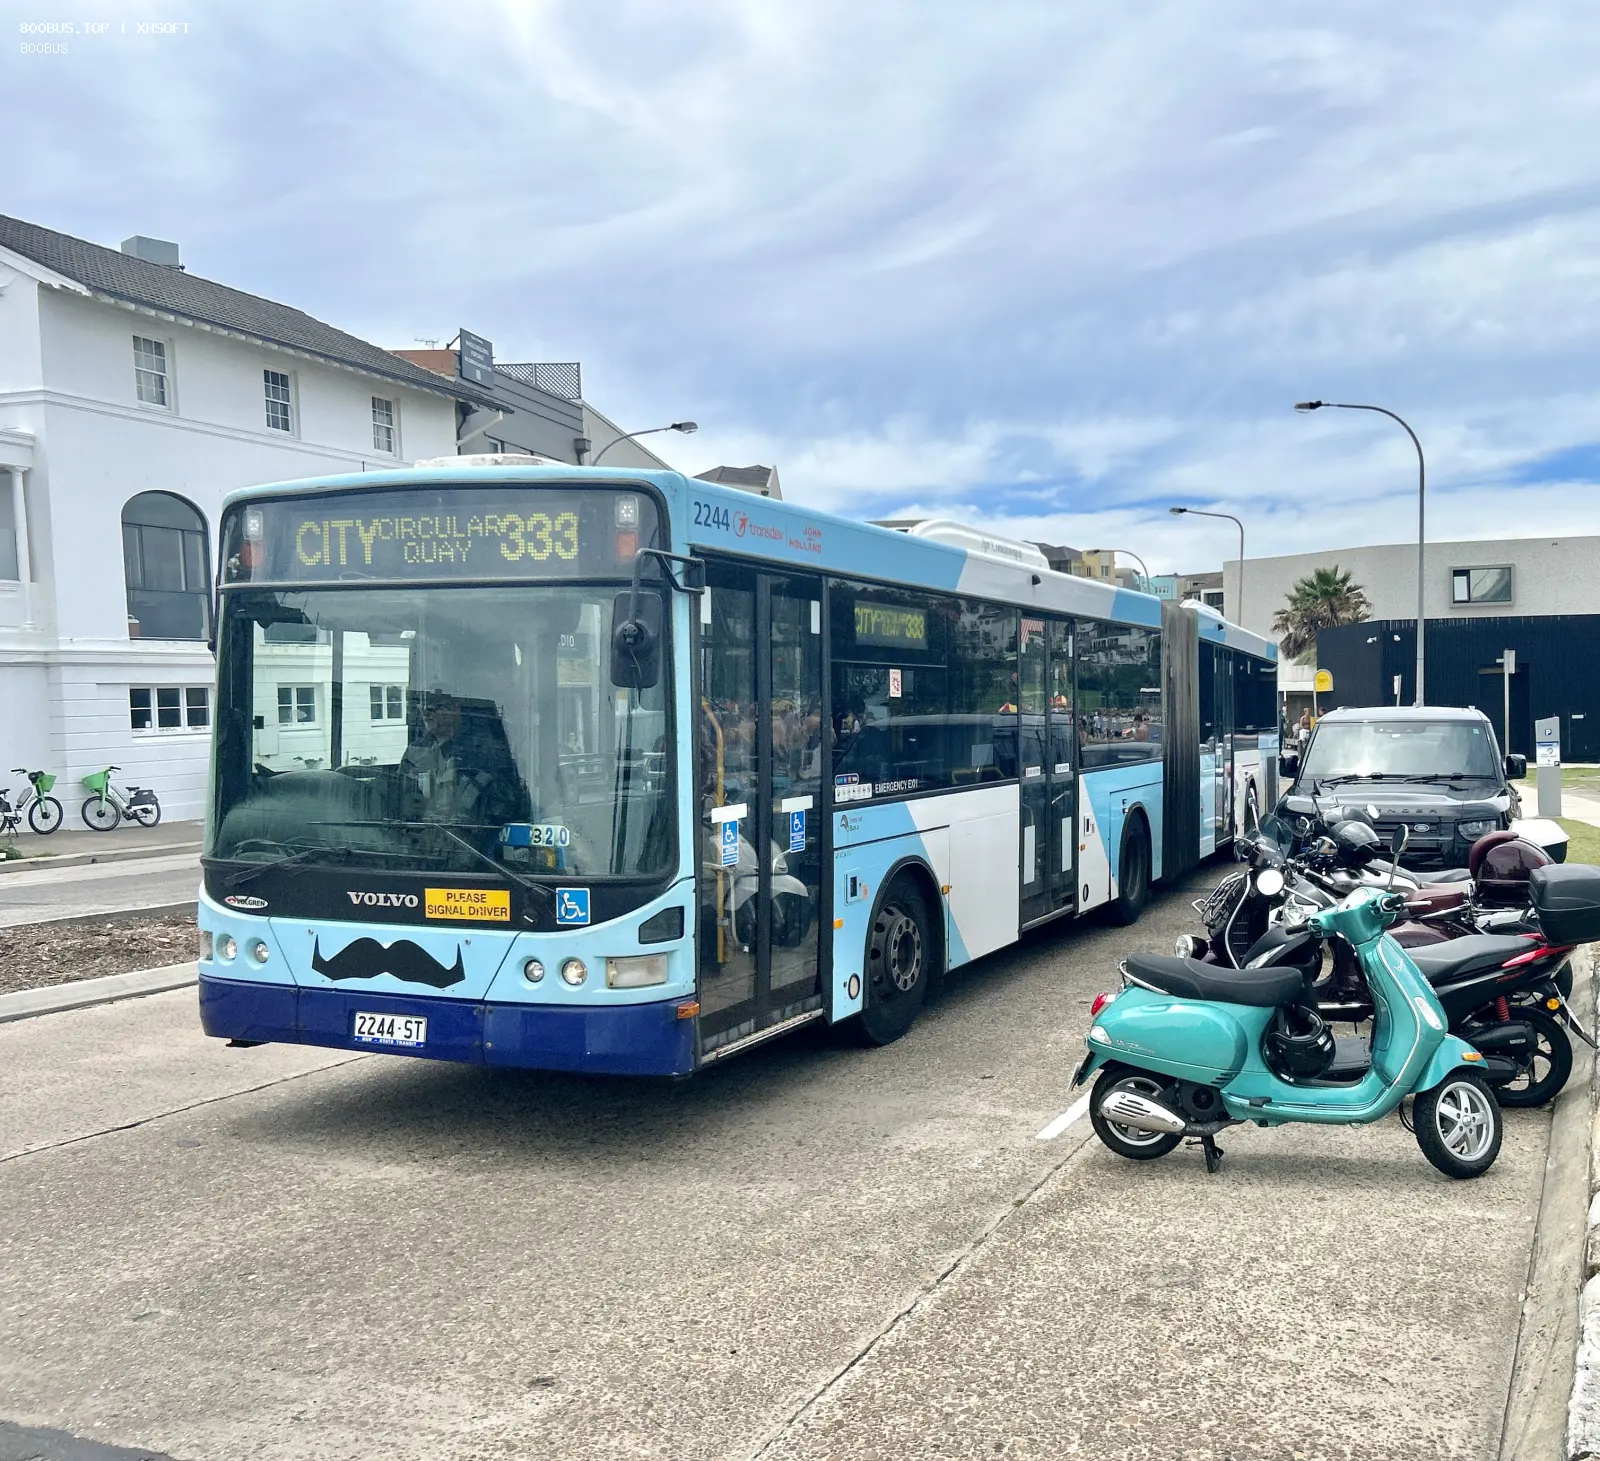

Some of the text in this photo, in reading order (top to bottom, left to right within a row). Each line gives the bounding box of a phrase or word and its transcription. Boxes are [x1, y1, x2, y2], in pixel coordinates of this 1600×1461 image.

[694, 501, 730, 531] 2244
[379, 515, 500, 539] CIRCULAR
[749, 522, 783, 541] transdev
[803, 526, 822, 538] JOHN
[296, 512, 579, 565] CITY 333
[789, 538, 822, 554] HOLLAND
[404, 541, 472, 563] QUAY
[875, 779, 908, 793] EMERGENCY
[533, 826, 568, 845] 320
[347, 891, 418, 908] VOLVO
[446, 892, 487, 903] PLEASE
[427, 904, 508, 917] SIGNAL DRIVER
[357, 1015, 423, 1041] 2244-ST
